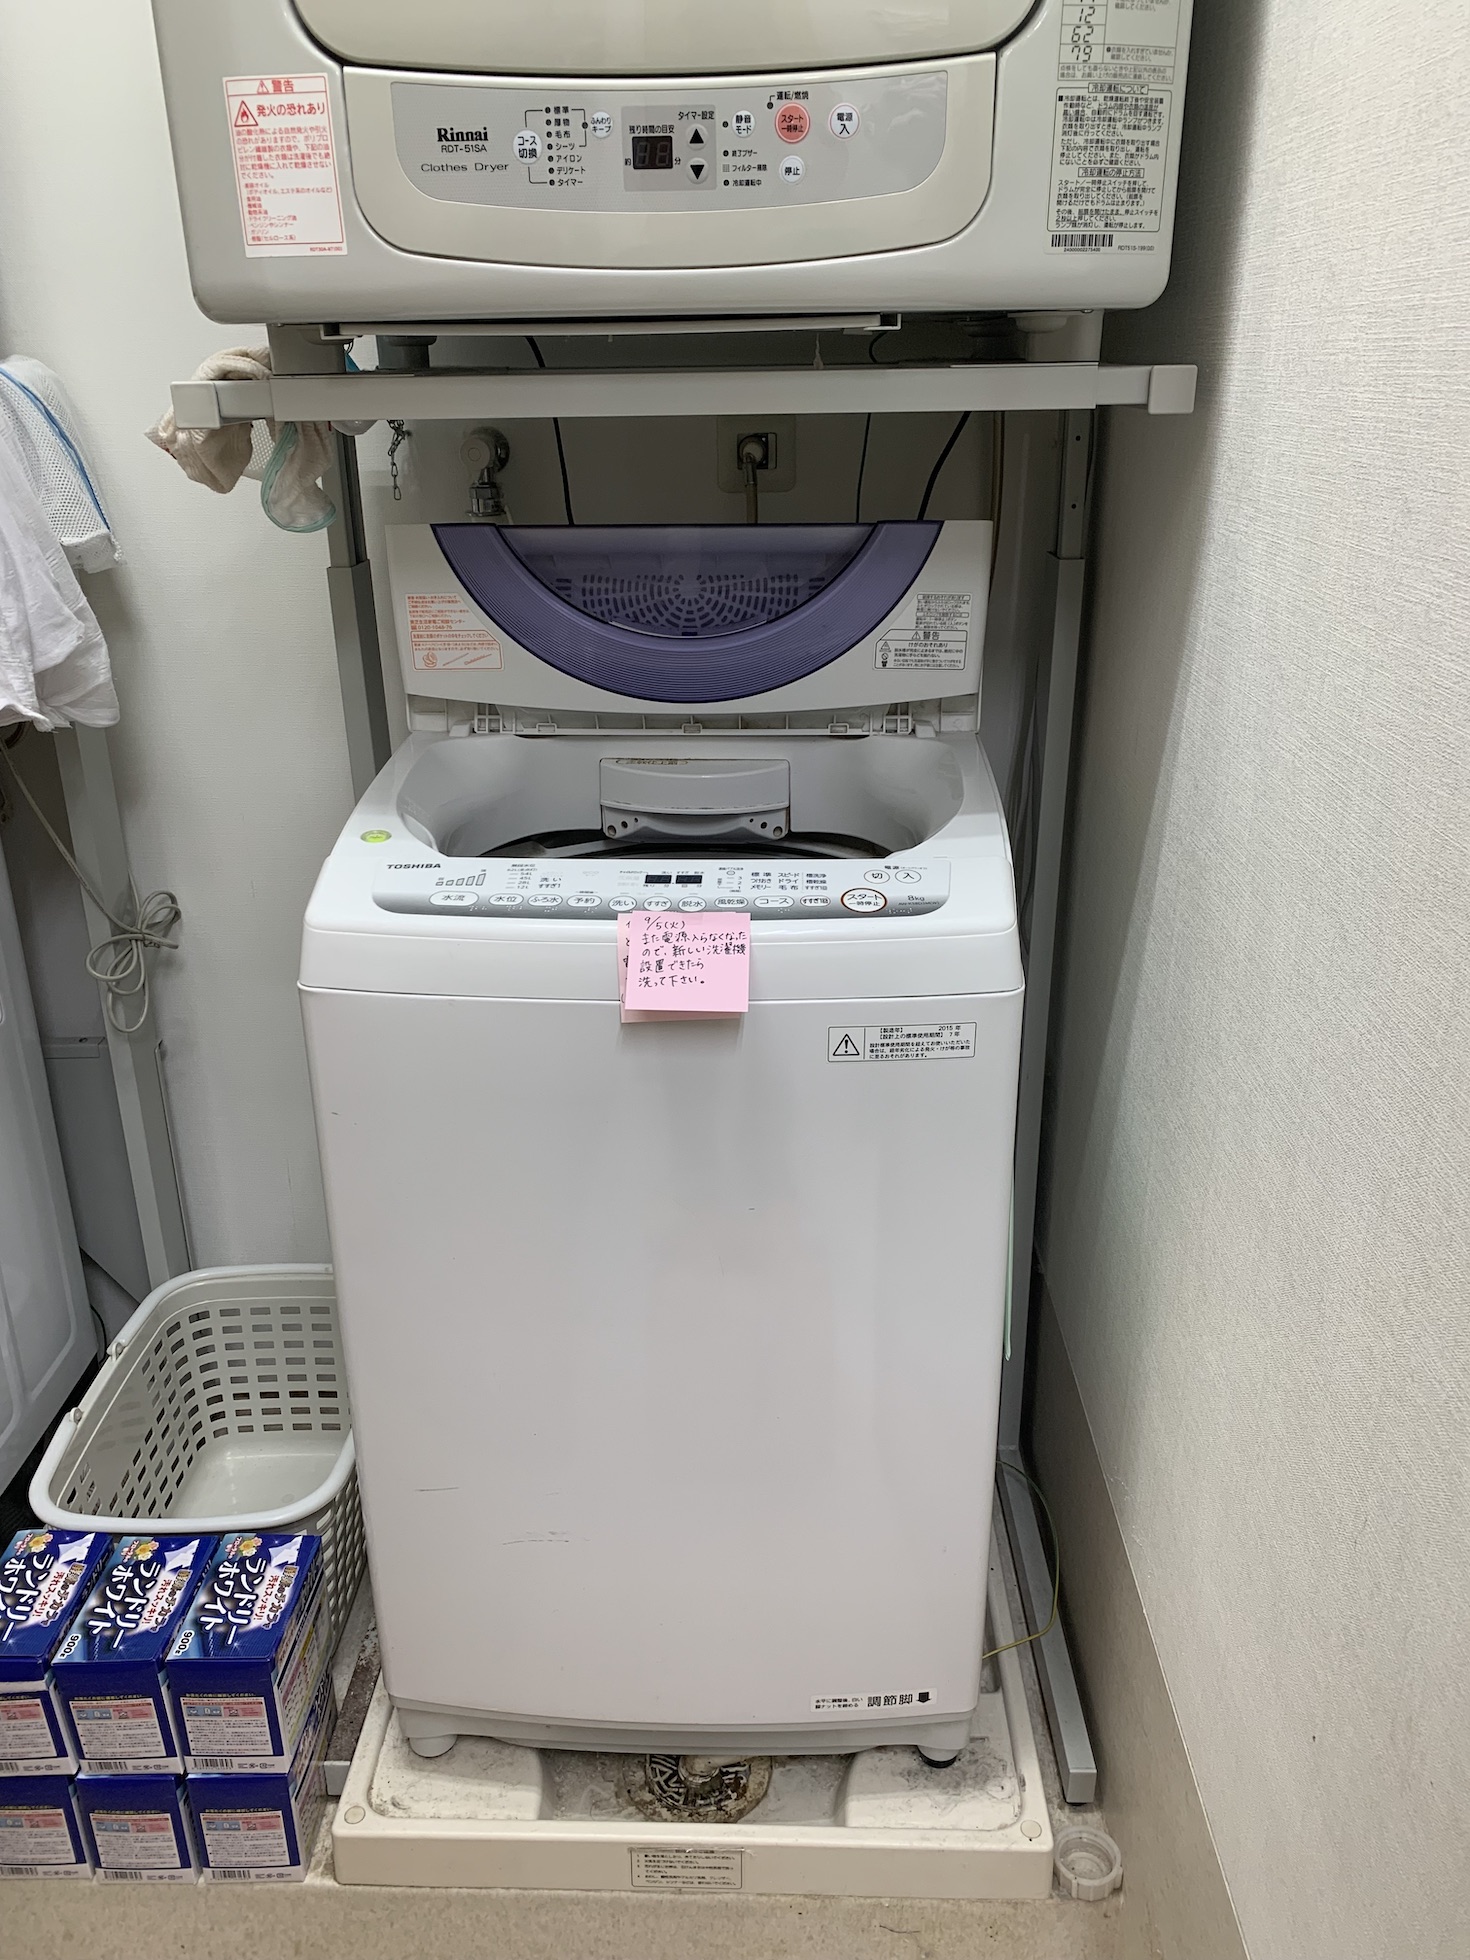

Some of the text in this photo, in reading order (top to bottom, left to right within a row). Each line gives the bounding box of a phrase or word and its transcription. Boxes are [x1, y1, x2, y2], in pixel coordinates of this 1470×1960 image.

[1071, 25, 1094, 43] 62
[271, 79, 294, 93] 警告
[256, 102, 326, 117] 発火の恐れあり
[736, 114, 752, 124] 静音
[781, 114, 804, 124] スタート
[836, 113, 853, 122] 電源
[736, 125, 752, 134] モード
[839, 123, 850, 134] 入
[436, 127, 488, 142] Rinnai
[554, 130, 570, 138] 毛布
[518, 136, 538, 146] コース
[556, 142, 575, 150] シーツ
[441, 144, 488, 153] RDT-51SA
[518, 148, 538, 159] 切換
[556, 154, 582, 163] アイロン
[674, 157, 681, 166] 分
[420, 162, 509, 173] Clothes Dryer
[784, 166, 800, 176] 停止
[557, 178, 583, 187] タイマー
[923, 631, 940, 640] 警告
[872, 872, 882, 880] 切
[902, 872, 914, 880] 入
[639, 958, 705, 974] 設置できたら
[2, 1554, 54, 1642] ランドリー
[88, 1564, 134, 1635] ホワイト
[199, 1560, 240, 1631] ホワイト
[112, 1562, 160, 1648] ランドリー
[227, 1558, 267, 1645] ランドリー
[867, 1693, 913, 1708] 調節脚
